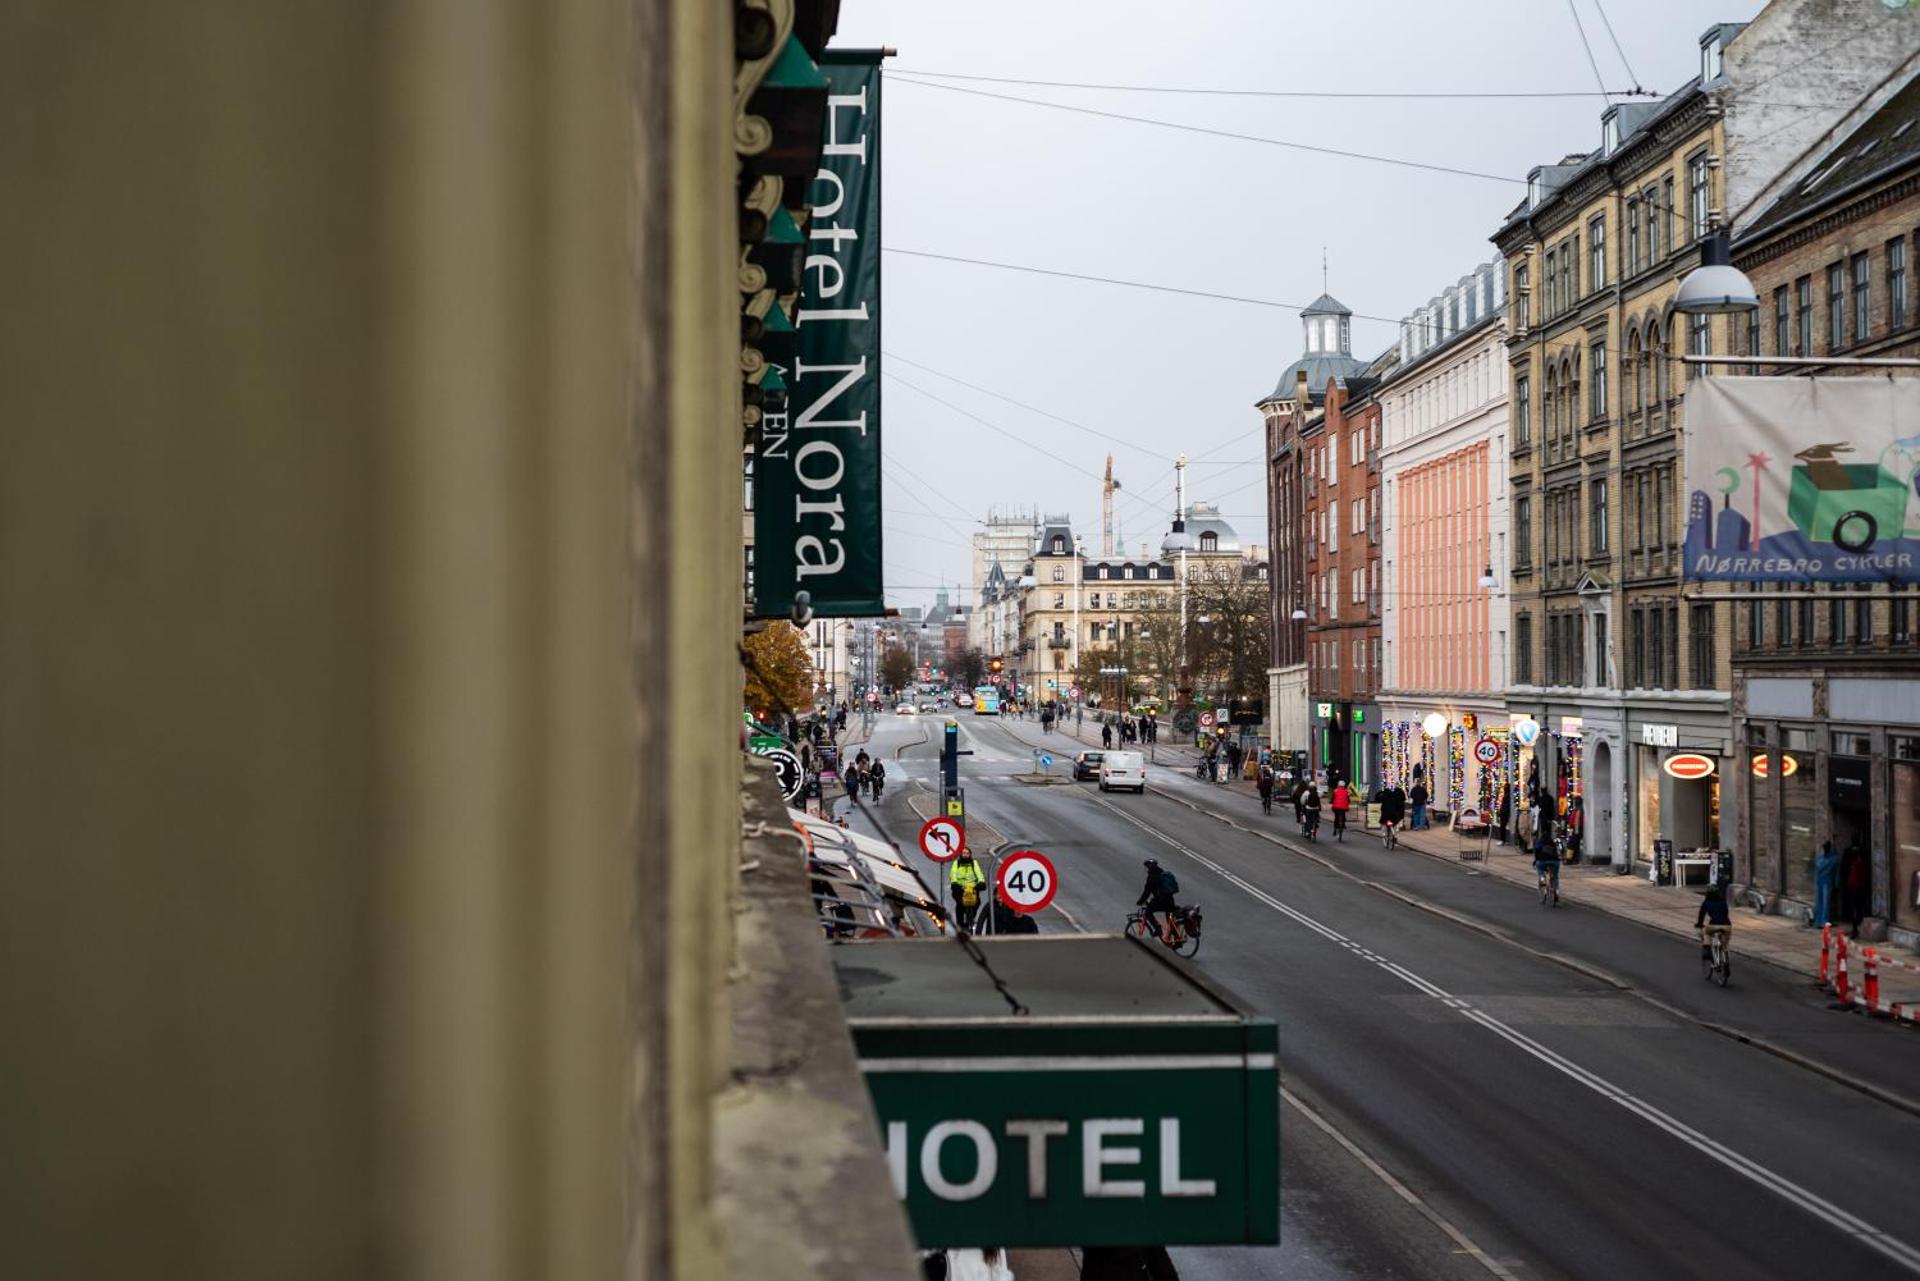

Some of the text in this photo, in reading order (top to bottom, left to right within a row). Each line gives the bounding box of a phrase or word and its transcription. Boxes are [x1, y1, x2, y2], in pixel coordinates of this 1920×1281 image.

[794, 85, 869, 582] Hotel Nora
[1695, 552, 1913, 574] NØRREBRO CYKLER
[1479, 746, 1496, 758] 40
[1007, 869, 1046, 893] 40
